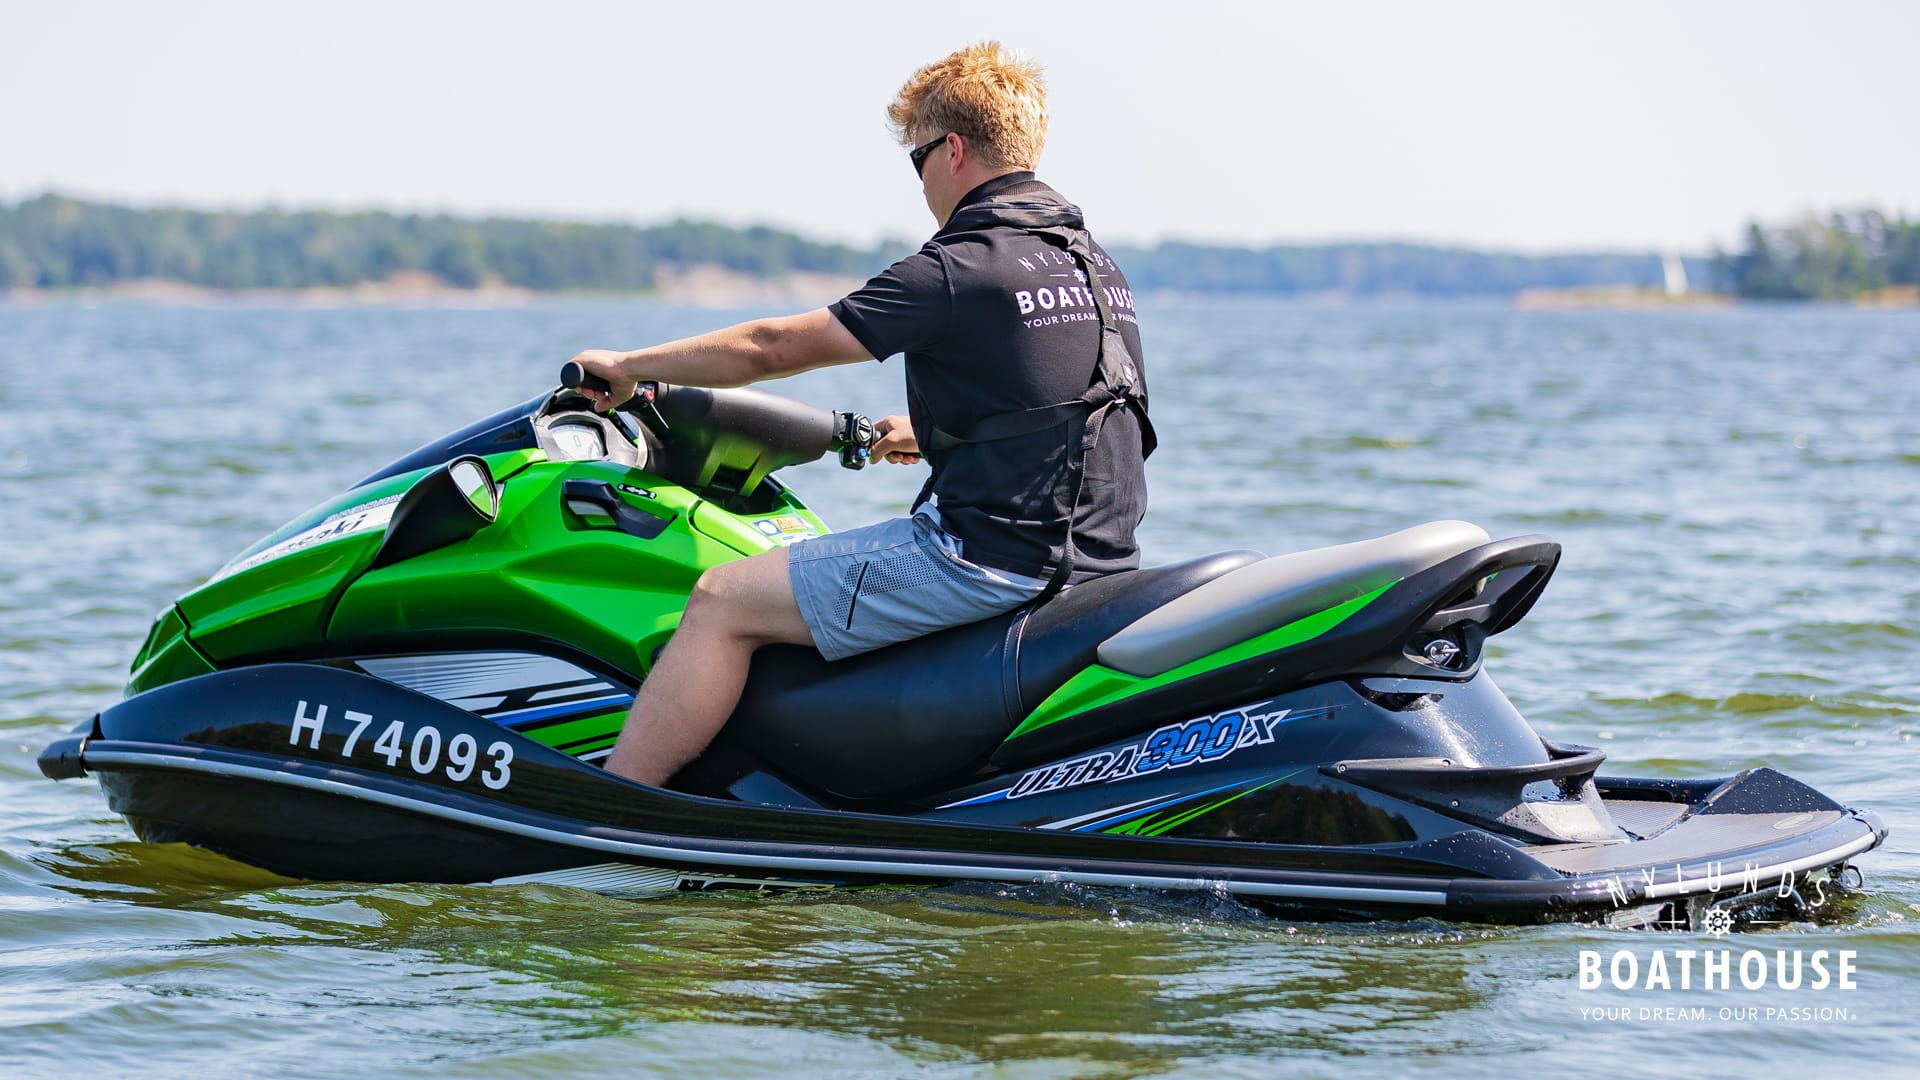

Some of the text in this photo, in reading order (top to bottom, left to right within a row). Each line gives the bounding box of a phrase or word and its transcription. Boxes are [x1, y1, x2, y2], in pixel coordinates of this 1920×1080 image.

[1018, 250, 1116, 272] NYLUD'S
[1024, 315, 1059, 328] YOUR
[289, 700, 514, 790] H 74093
[1006, 744, 1139, 799] ULTRA
